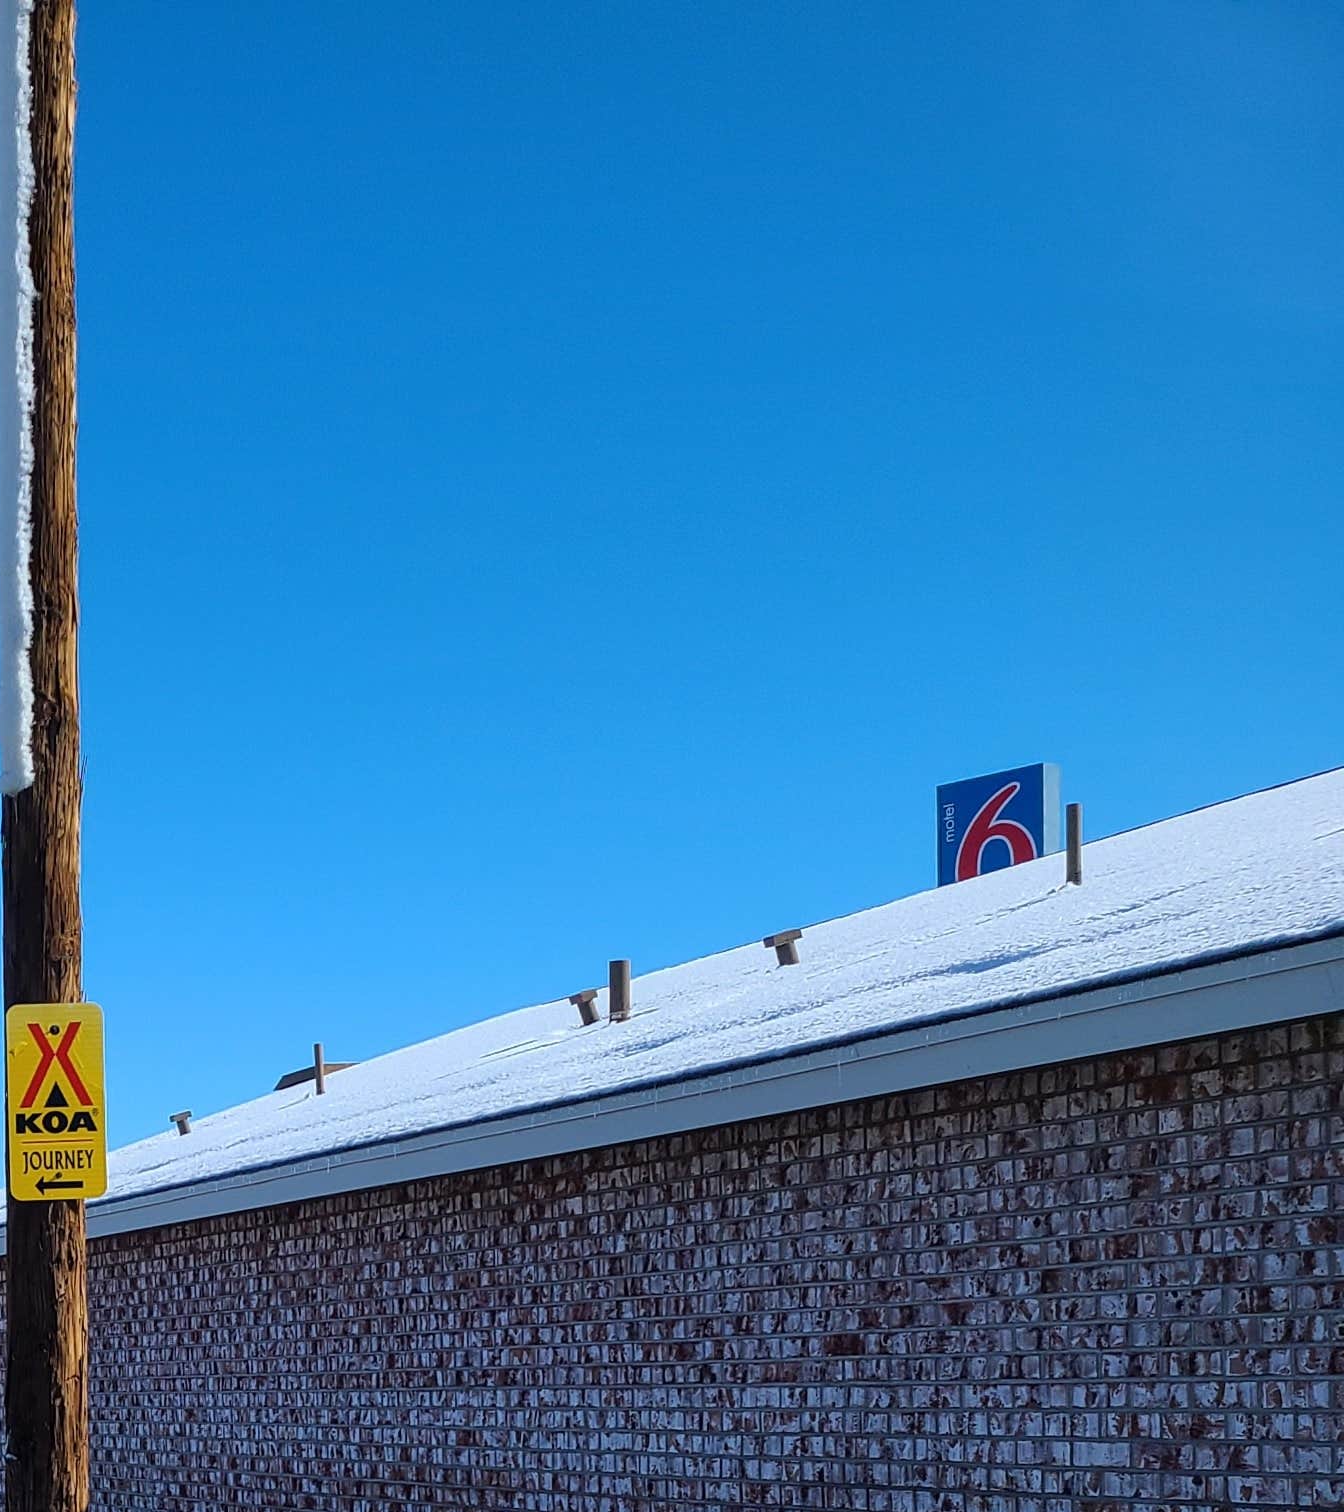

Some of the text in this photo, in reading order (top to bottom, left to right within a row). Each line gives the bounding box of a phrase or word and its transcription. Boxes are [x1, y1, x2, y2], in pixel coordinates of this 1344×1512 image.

[943, 803, 955, 842] motel
[955, 781, 1038, 883] 6
[15, 1110, 98, 1134] KOA
[22, 1149, 94, 1174] JOURNEY
